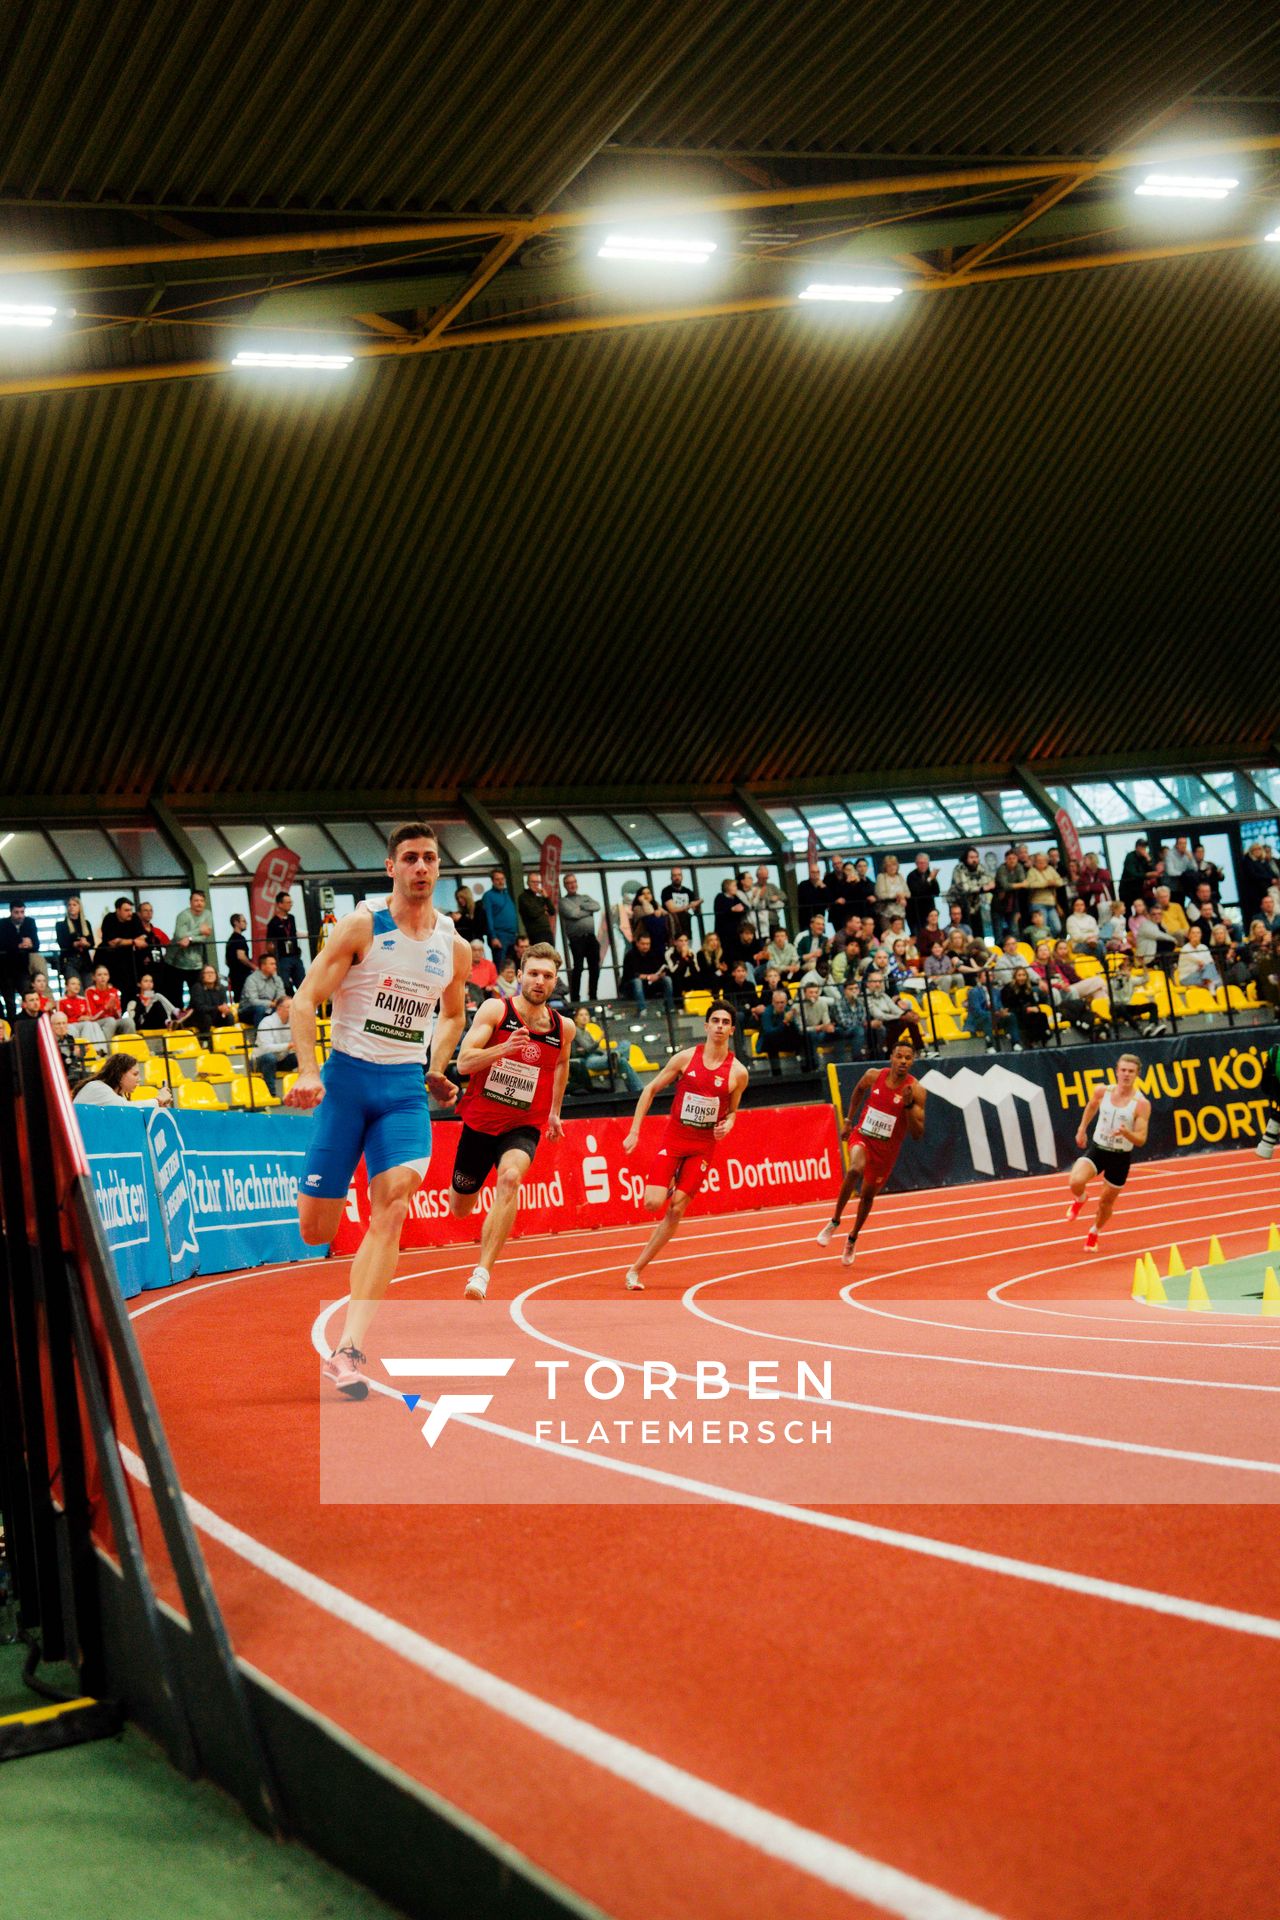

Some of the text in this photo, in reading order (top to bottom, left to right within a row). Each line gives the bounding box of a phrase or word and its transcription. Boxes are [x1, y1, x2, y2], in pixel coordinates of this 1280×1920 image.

[255, 857, 288, 925] LGO
[375, 992, 431, 1018] RAIMONDI
[370, 1023, 405, 1038] DORTMUND
[393, 1013, 412, 1028] 149
[490, 1070, 535, 1092] DAMMERMANN
[1208, 1045, 1268, 1092] KÖ
[503, 1087, 515, 1098] 32
[685, 1104, 716, 1116] AFONSO
[1173, 1098, 1280, 1147] DORT
[727, 1147, 832, 1190] Dortmund
[221, 1162, 301, 1212] Nachrichte
